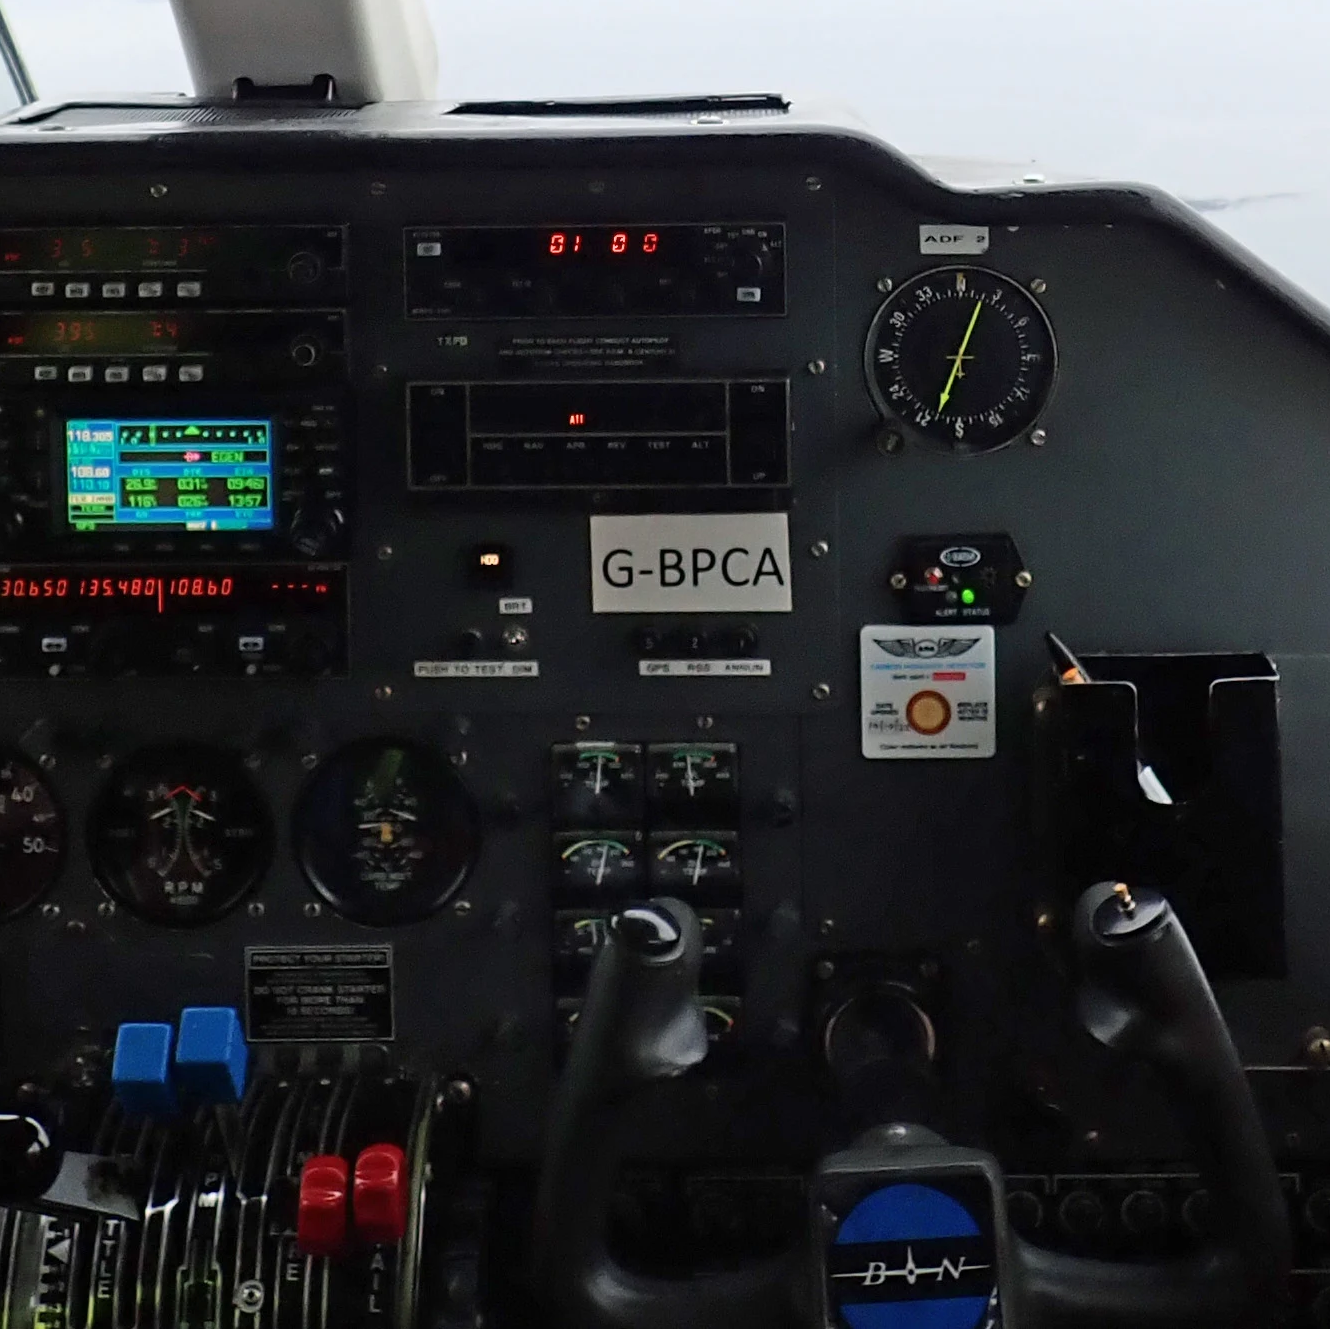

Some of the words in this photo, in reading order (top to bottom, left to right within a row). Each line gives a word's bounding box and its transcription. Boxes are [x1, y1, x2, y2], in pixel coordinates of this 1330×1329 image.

[924, 235, 964, 243] ADF
[975, 235, 986, 243] 2
[915, 285, 934, 302] 33
[992, 288, 1003, 302] 3
[889, 311, 906, 328] 30
[877, 348, 894, 363] W
[954, 422, 965, 439] S
[602, 547, 784, 589] G-BPCA
[79, 577, 157, 596] 135.480
[170, 577, 234, 596] 108.60
[504, 602, 527, 611] BRT
[418, 665, 449, 675] PUSH
[454, 665, 469, 674] TO
[474, 665, 502, 674] TEST
[647, 663, 670, 672] GPS
[11, 786, 35, 803] 40
[22, 837, 45, 854] 50
